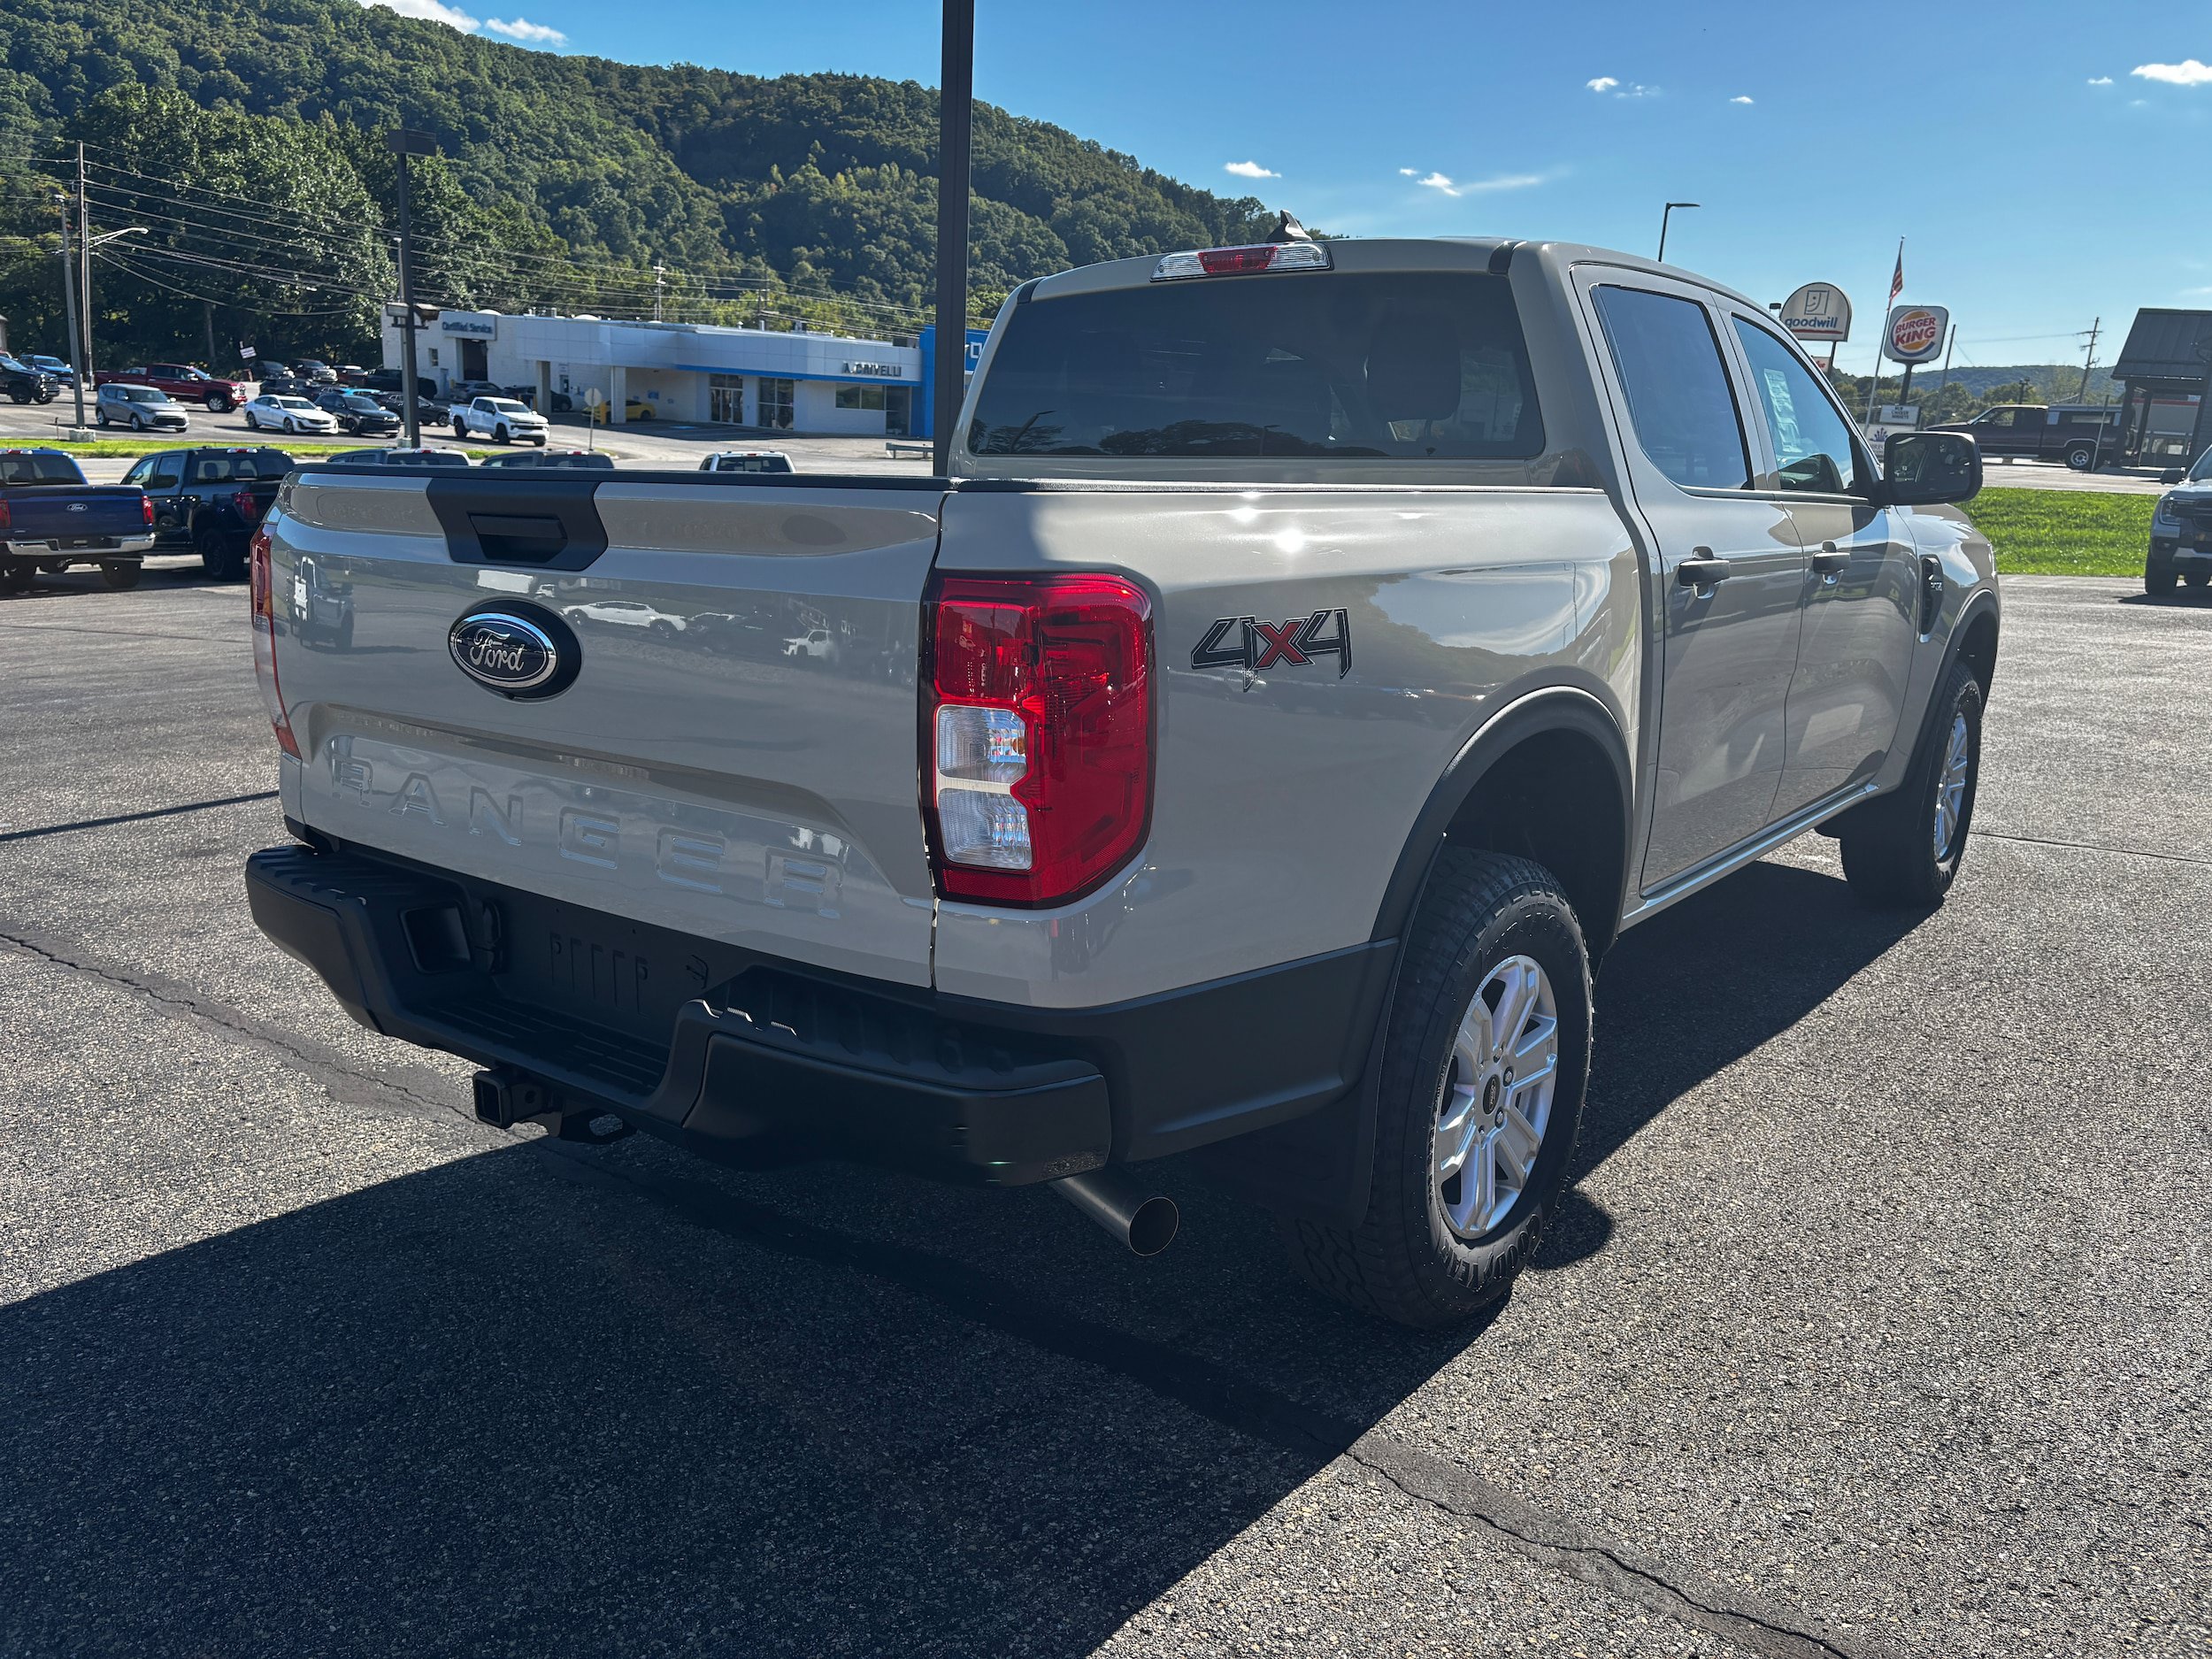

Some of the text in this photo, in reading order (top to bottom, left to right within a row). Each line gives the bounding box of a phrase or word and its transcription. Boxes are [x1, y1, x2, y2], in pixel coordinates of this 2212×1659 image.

[1785, 317, 1839, 328] goodwill
[1895, 317, 1936, 333] BURGER
[1894, 327, 1936, 347] KING
[469, 627, 524, 672] Ford
[331, 754, 844, 919] RANGER
